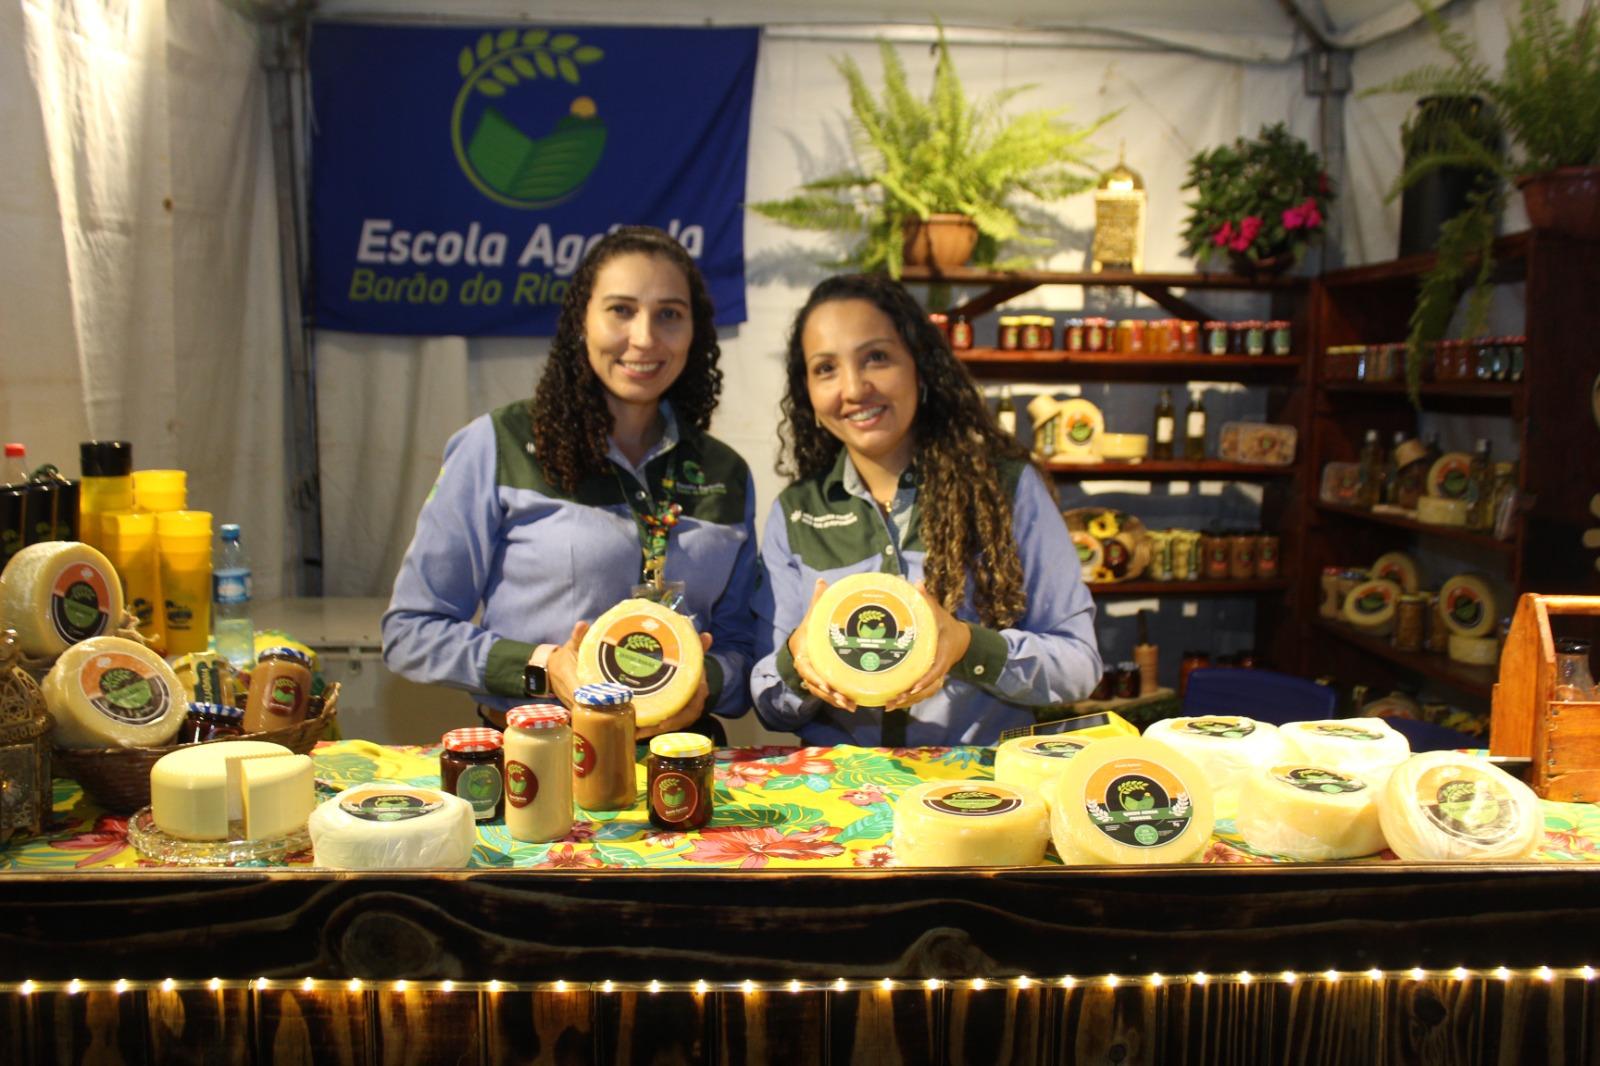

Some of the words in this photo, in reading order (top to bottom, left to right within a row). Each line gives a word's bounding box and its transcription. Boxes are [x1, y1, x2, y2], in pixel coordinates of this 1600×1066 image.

[357, 219, 507, 265] Escola
[348, 268, 449, 304] Barão
[459, 272, 503, 306] do
